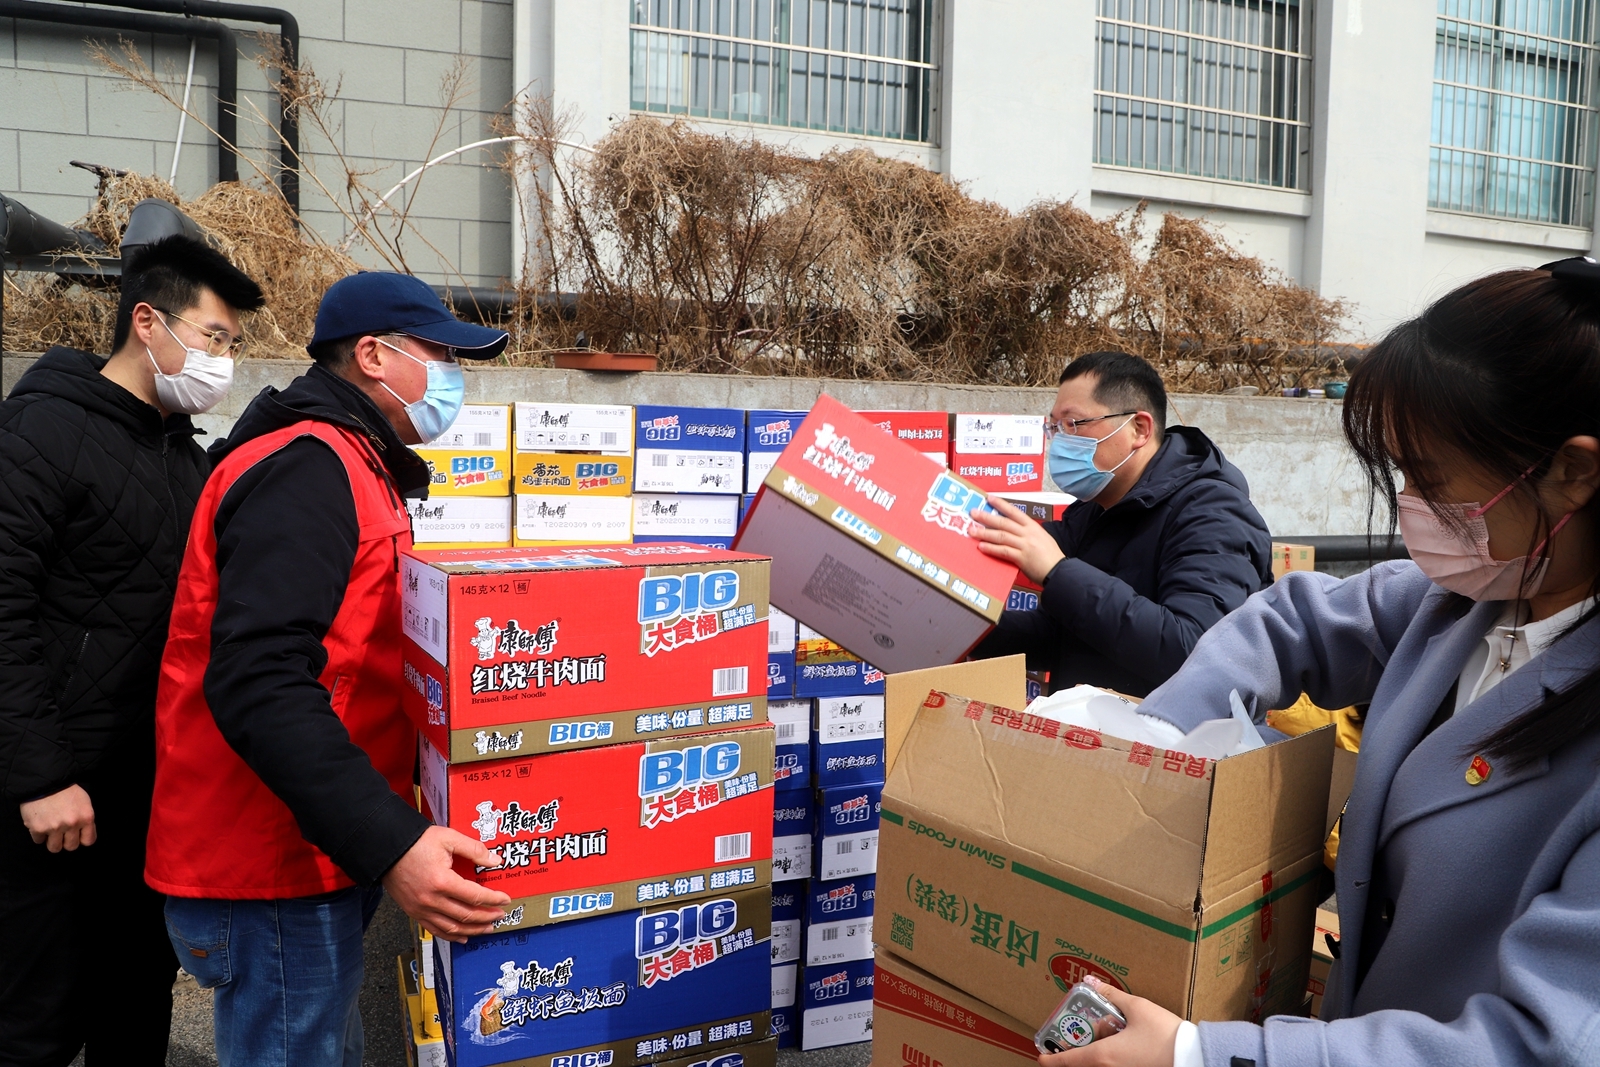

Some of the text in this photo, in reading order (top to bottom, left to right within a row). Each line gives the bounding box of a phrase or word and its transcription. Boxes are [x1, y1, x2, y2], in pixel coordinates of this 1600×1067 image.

[646, 426, 681, 440] BIG
[760, 430, 792, 445] BIG
[452, 457, 494, 473] BIG
[532, 463, 560, 476] 番茄
[576, 463, 618, 478] BIG
[960, 466, 1002, 477] 红烧牛肉面
[1008, 463, 1033, 475] BIG
[454, 473, 485, 487] 大食桶
[522, 476, 571, 486] 鸡蛋牛肉面
[578, 478, 609, 490] 大食桶
[803, 445, 897, 511] 红烧牛肉面
[460, 583, 509, 595] 145克×12
[639, 572, 738, 623] BIG
[1007, 589, 1039, 611] BIG
[647, 613, 719, 653] 大食桶
[722, 614, 756, 632] 超满足
[498, 620, 556, 656] 康師傅
[471, 654, 607, 695] 红烧牛肉面
[864, 671, 885, 685] 大食
[426, 674, 442, 709] BIG
[471, 691, 547, 704] Braised Beef Noodle
[487, 702, 753, 751] 康師傅 BIG桶 美味·份量 超满足
[640, 742, 740, 796] BIG
[775, 754, 798, 770] IG
[1163, 749, 1209, 779] 食品
[462, 769, 511, 782] 145克×12
[724, 773, 757, 788] 美味·份量
[725, 782, 758, 799] 超满足
[648, 784, 720, 826] 大食桶
[836, 805, 870, 825] BIG
[500, 801, 558, 836] 康師傅
[907, 820, 1007, 870] Siwin Foods
[475, 867, 549, 884] Braised Beef Noodle
[551, 892, 613, 915] BIG桶
[637, 876, 705, 902] 美味·份量
[710, 867, 756, 890] 超满足
[822, 893, 857, 913] BIG
[637, 899, 736, 957] BIG
[721, 928, 753, 945] 美味·份量
[722, 937, 754, 955] 超满足
[645, 941, 716, 986] 大食桶
[1055, 937, 1130, 977] Siwin Foods
[522, 959, 573, 989] 康師傅
[815, 980, 849, 1000] BIG
[500, 982, 628, 1026] 鲜虾鱼板面
[636, 1030, 703, 1058] 美味·份量
[708, 1020, 753, 1042] 超满足
